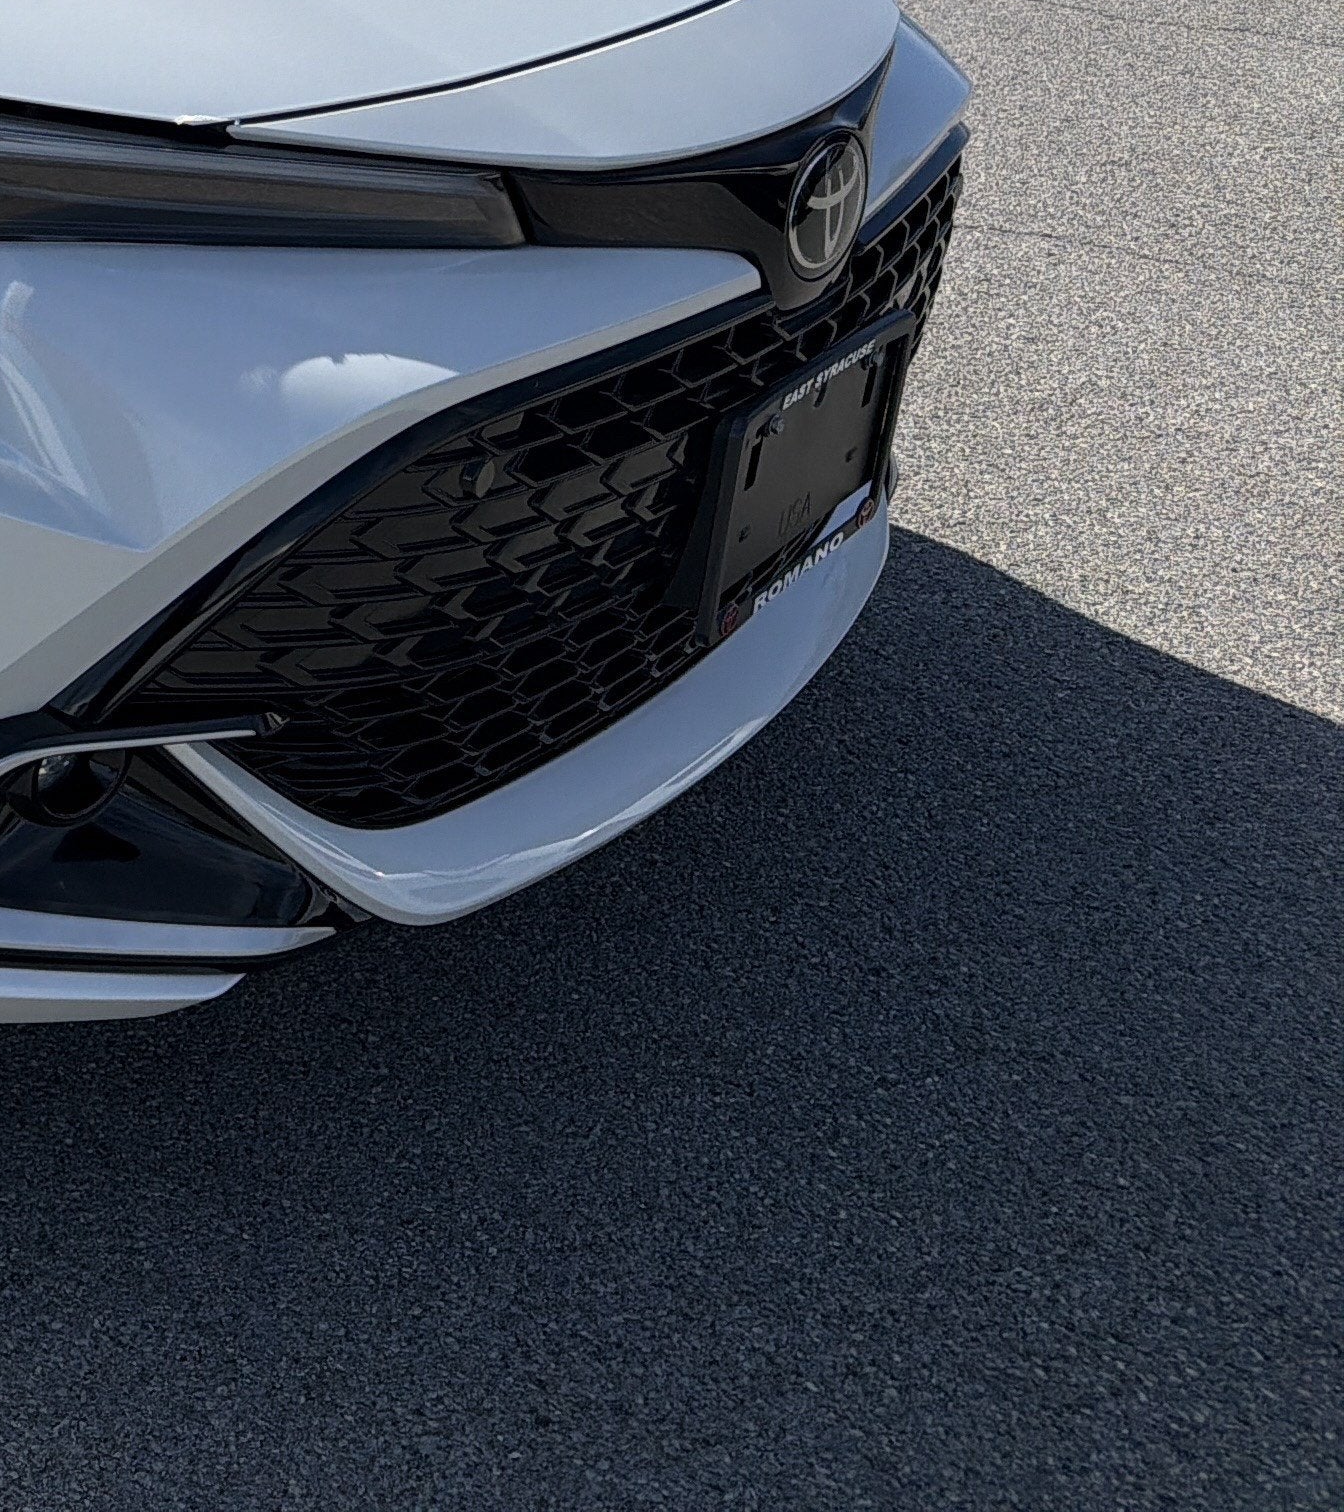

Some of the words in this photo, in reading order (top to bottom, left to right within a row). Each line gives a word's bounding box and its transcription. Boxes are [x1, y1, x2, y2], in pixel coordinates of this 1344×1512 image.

[782, 378, 812, 411] EAST
[813, 338, 877, 388] SYRACUSE
[778, 491, 811, 536] USA
[752, 531, 845, 614] ROMANO
